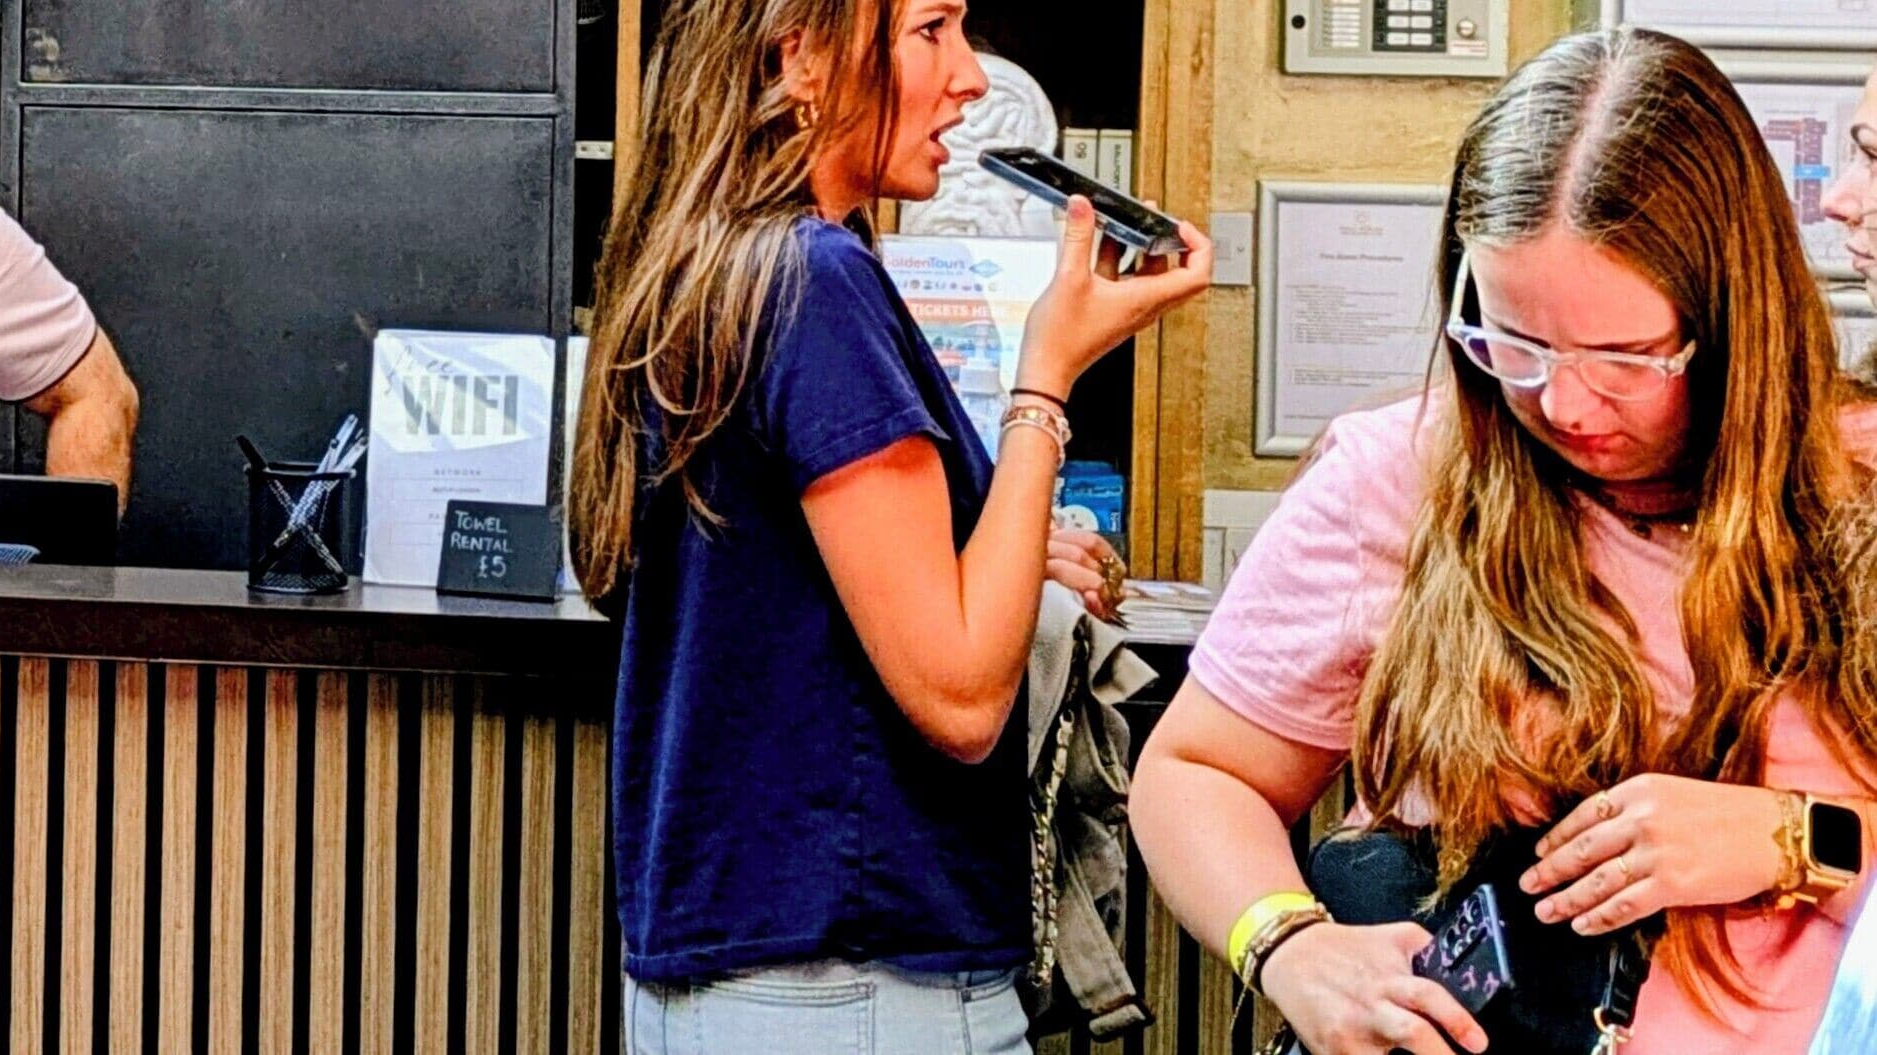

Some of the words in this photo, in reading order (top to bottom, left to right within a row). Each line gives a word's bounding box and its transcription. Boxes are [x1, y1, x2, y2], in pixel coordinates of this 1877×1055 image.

[402, 375, 519, 435] WIFI
[454, 509, 508, 533] TOWEL
[450, 531, 514, 553] RENTAL
[477, 555, 507, 578] £5
